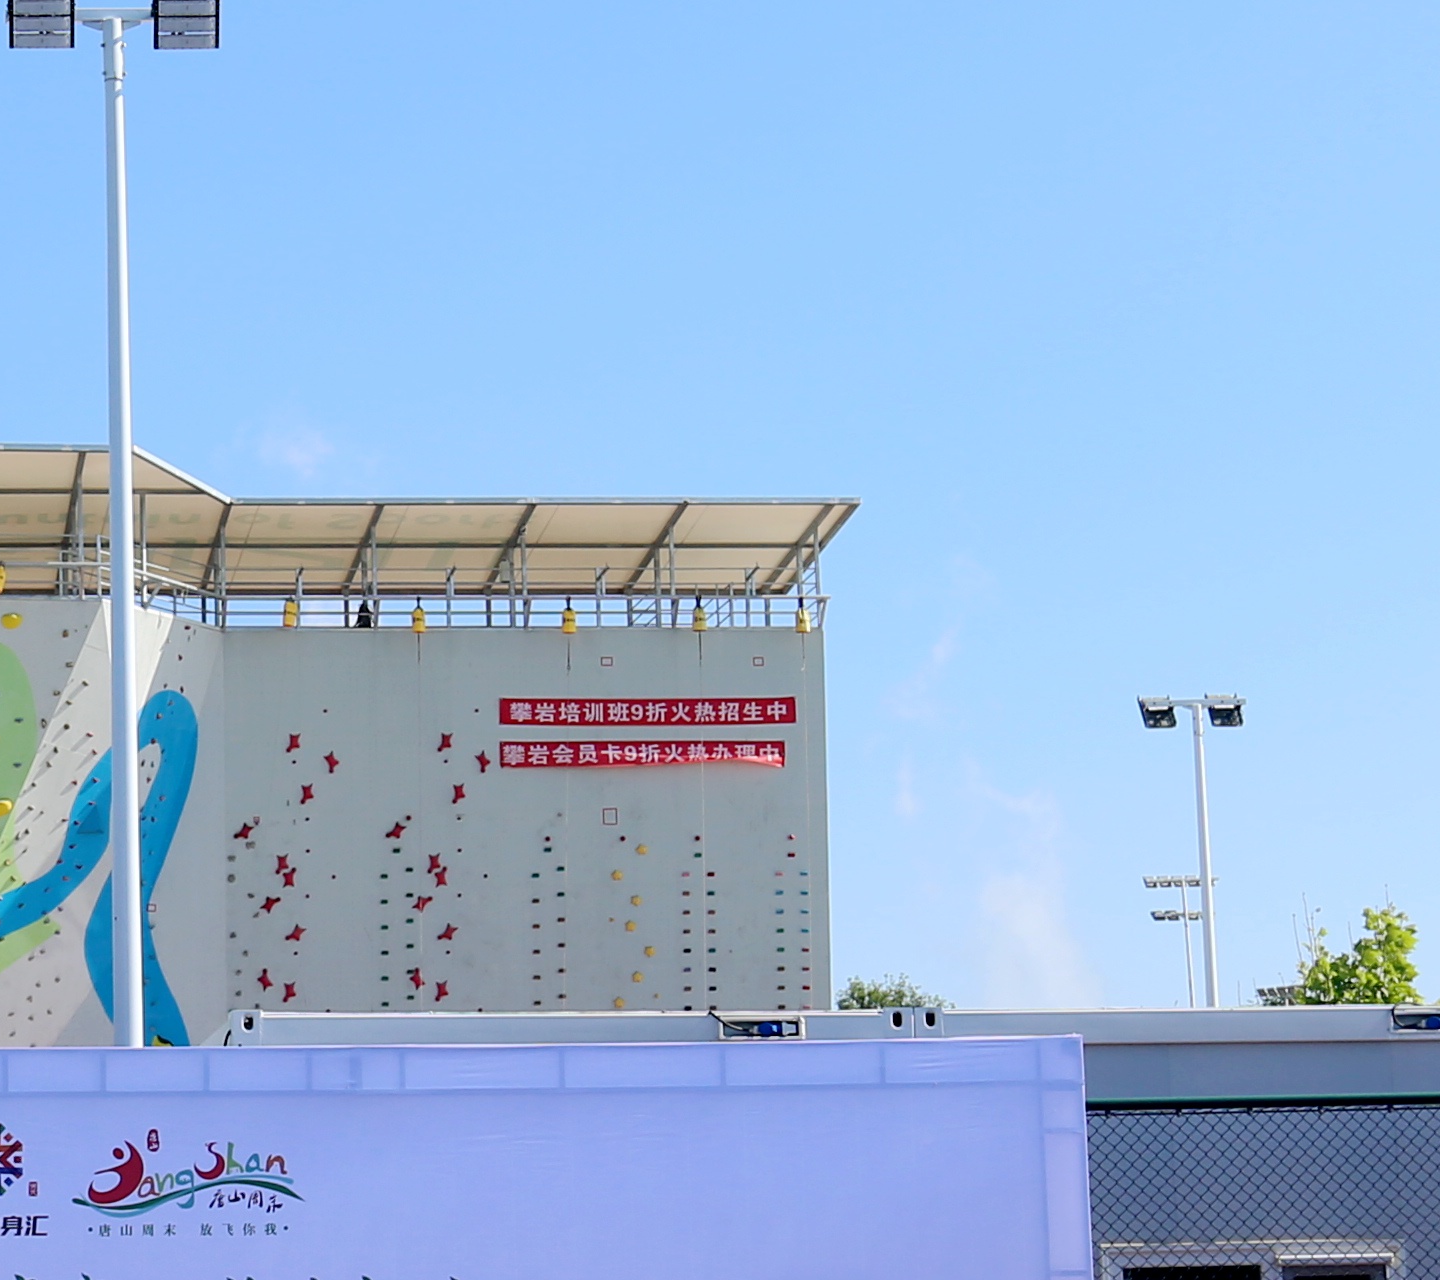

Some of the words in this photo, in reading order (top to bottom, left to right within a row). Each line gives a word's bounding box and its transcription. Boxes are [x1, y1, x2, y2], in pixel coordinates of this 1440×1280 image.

[509, 701, 788, 723] 攀岩培训班9折火热招生中
[502, 744, 780, 766] 攀岩会员卡9折火热办理中
[98, 1223, 177, 1237] 唐山周末
[200, 1223, 278, 1237] 放飞你我
